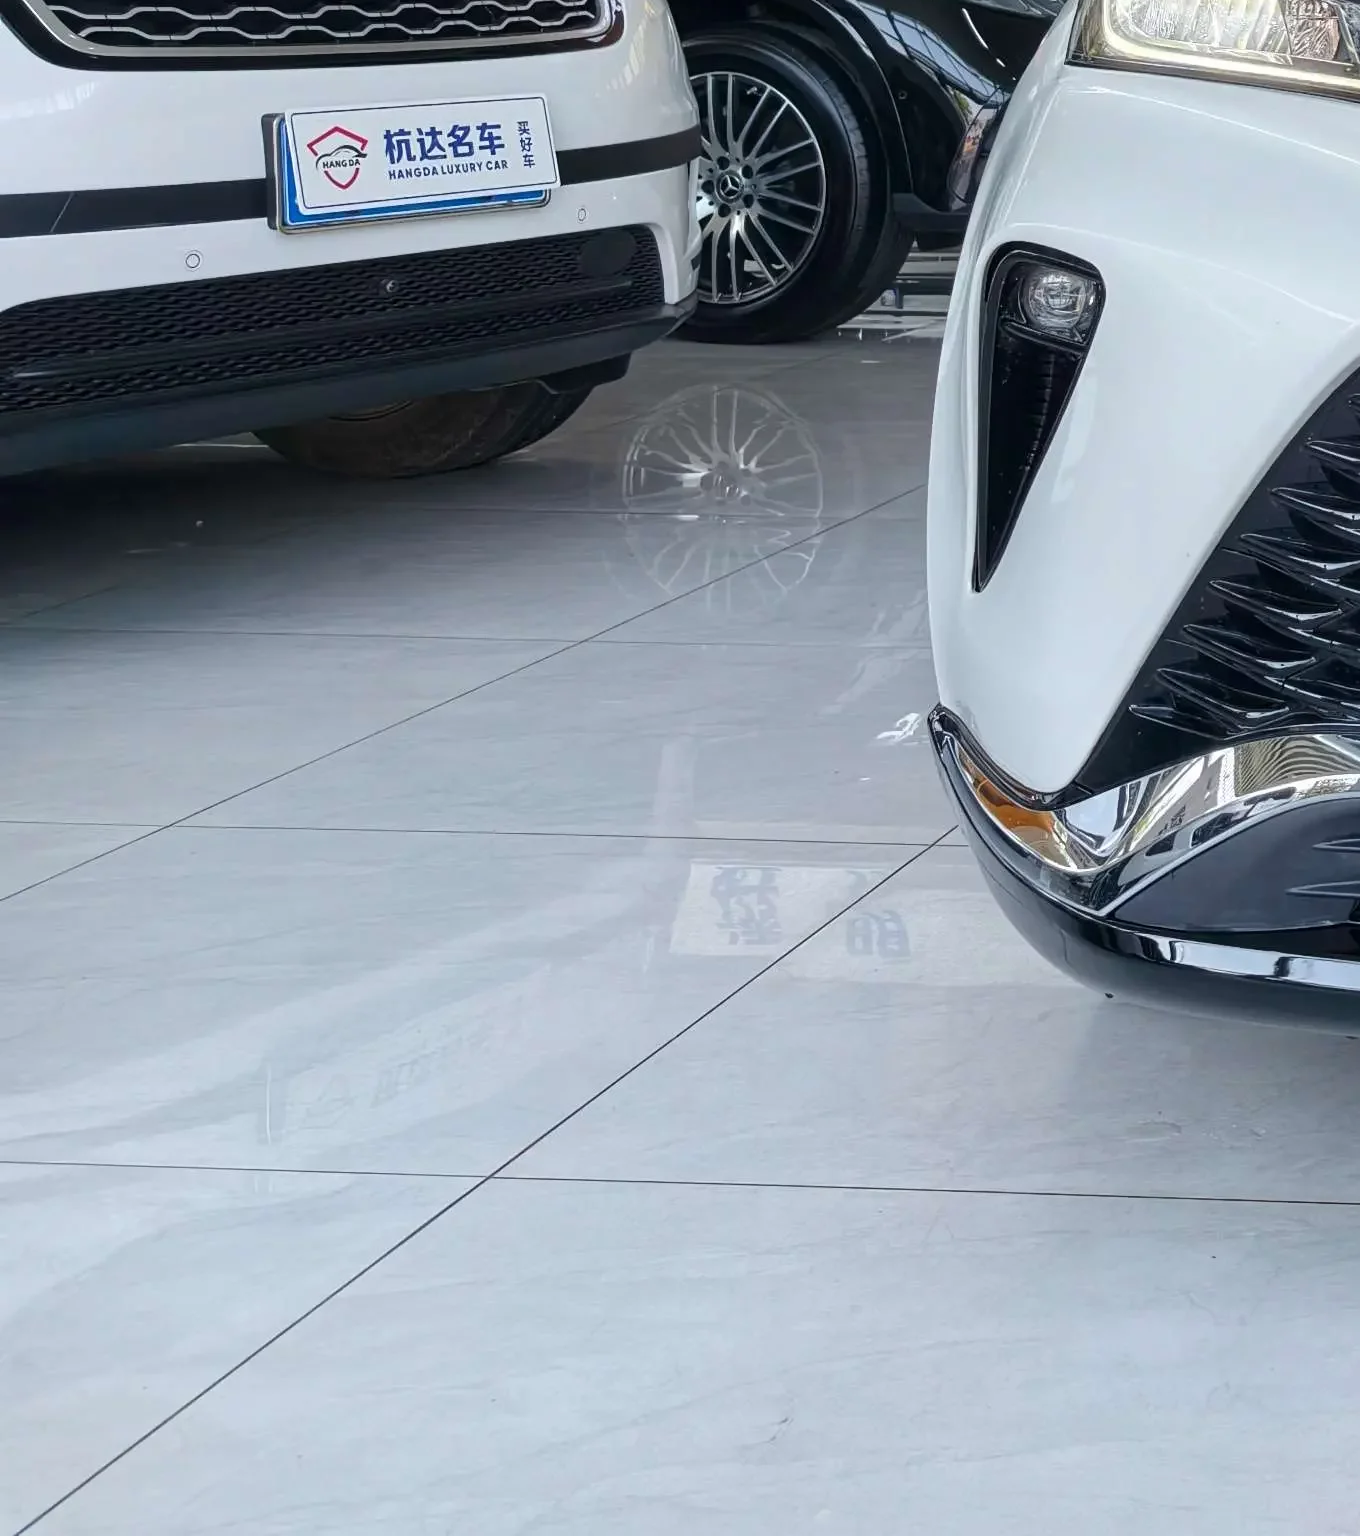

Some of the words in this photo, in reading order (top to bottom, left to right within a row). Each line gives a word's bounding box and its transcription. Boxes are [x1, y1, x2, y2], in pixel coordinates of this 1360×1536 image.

[383, 122, 505, 165] 杭达名车
[517, 120, 536, 169] 买好车
[322, 160, 348, 169] HANG
[348, 158, 361, 167] DA
[388, 166, 439, 181] HANGDA
[441, 161, 483, 175] LUXURY
[486, 159, 509, 171] CAR
